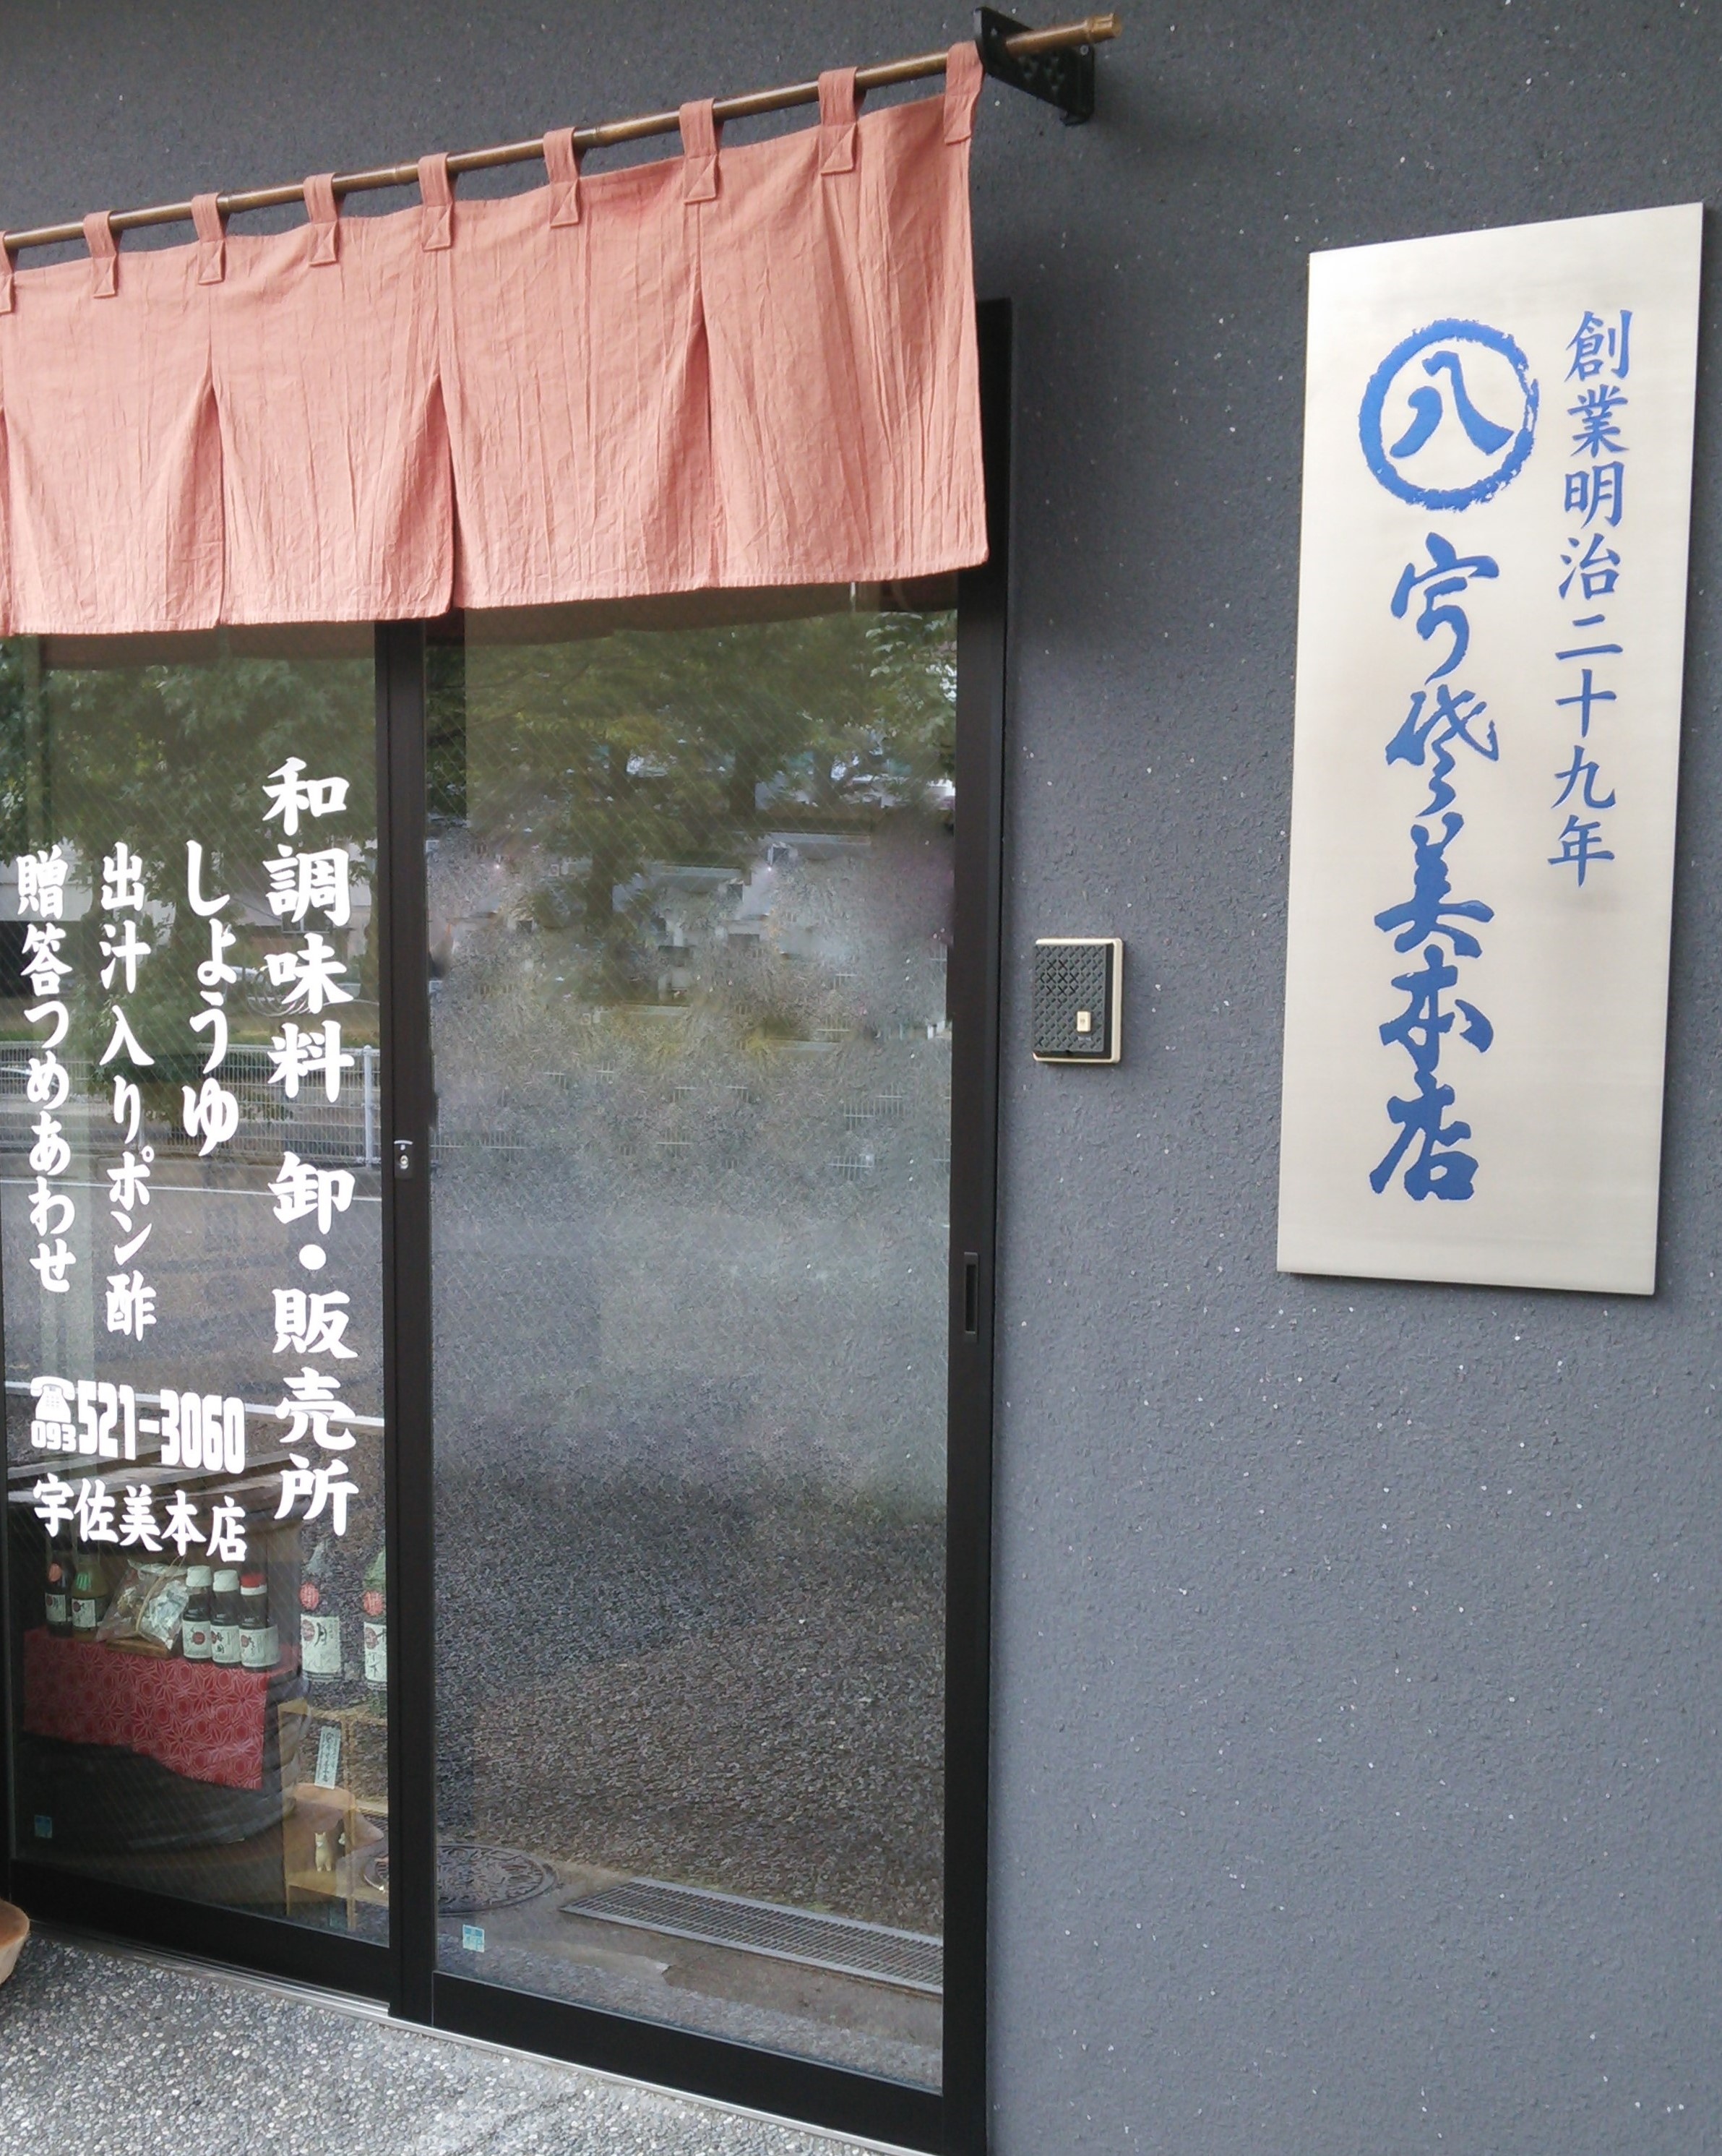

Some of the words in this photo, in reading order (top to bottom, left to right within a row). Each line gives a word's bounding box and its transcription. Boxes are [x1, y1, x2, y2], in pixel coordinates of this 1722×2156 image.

[1547, 310, 1633, 887] 創業明治二十九年
[16, 844, 76, 1293] 贈答つめあわせ
[99, 841, 158, 1341] 出汁入りポン酢
[30, 1420, 76, 1452] 093
[77, 1379, 246, 1474] 521-3060
[33, 1472, 247, 1562] 宇佐美本店
